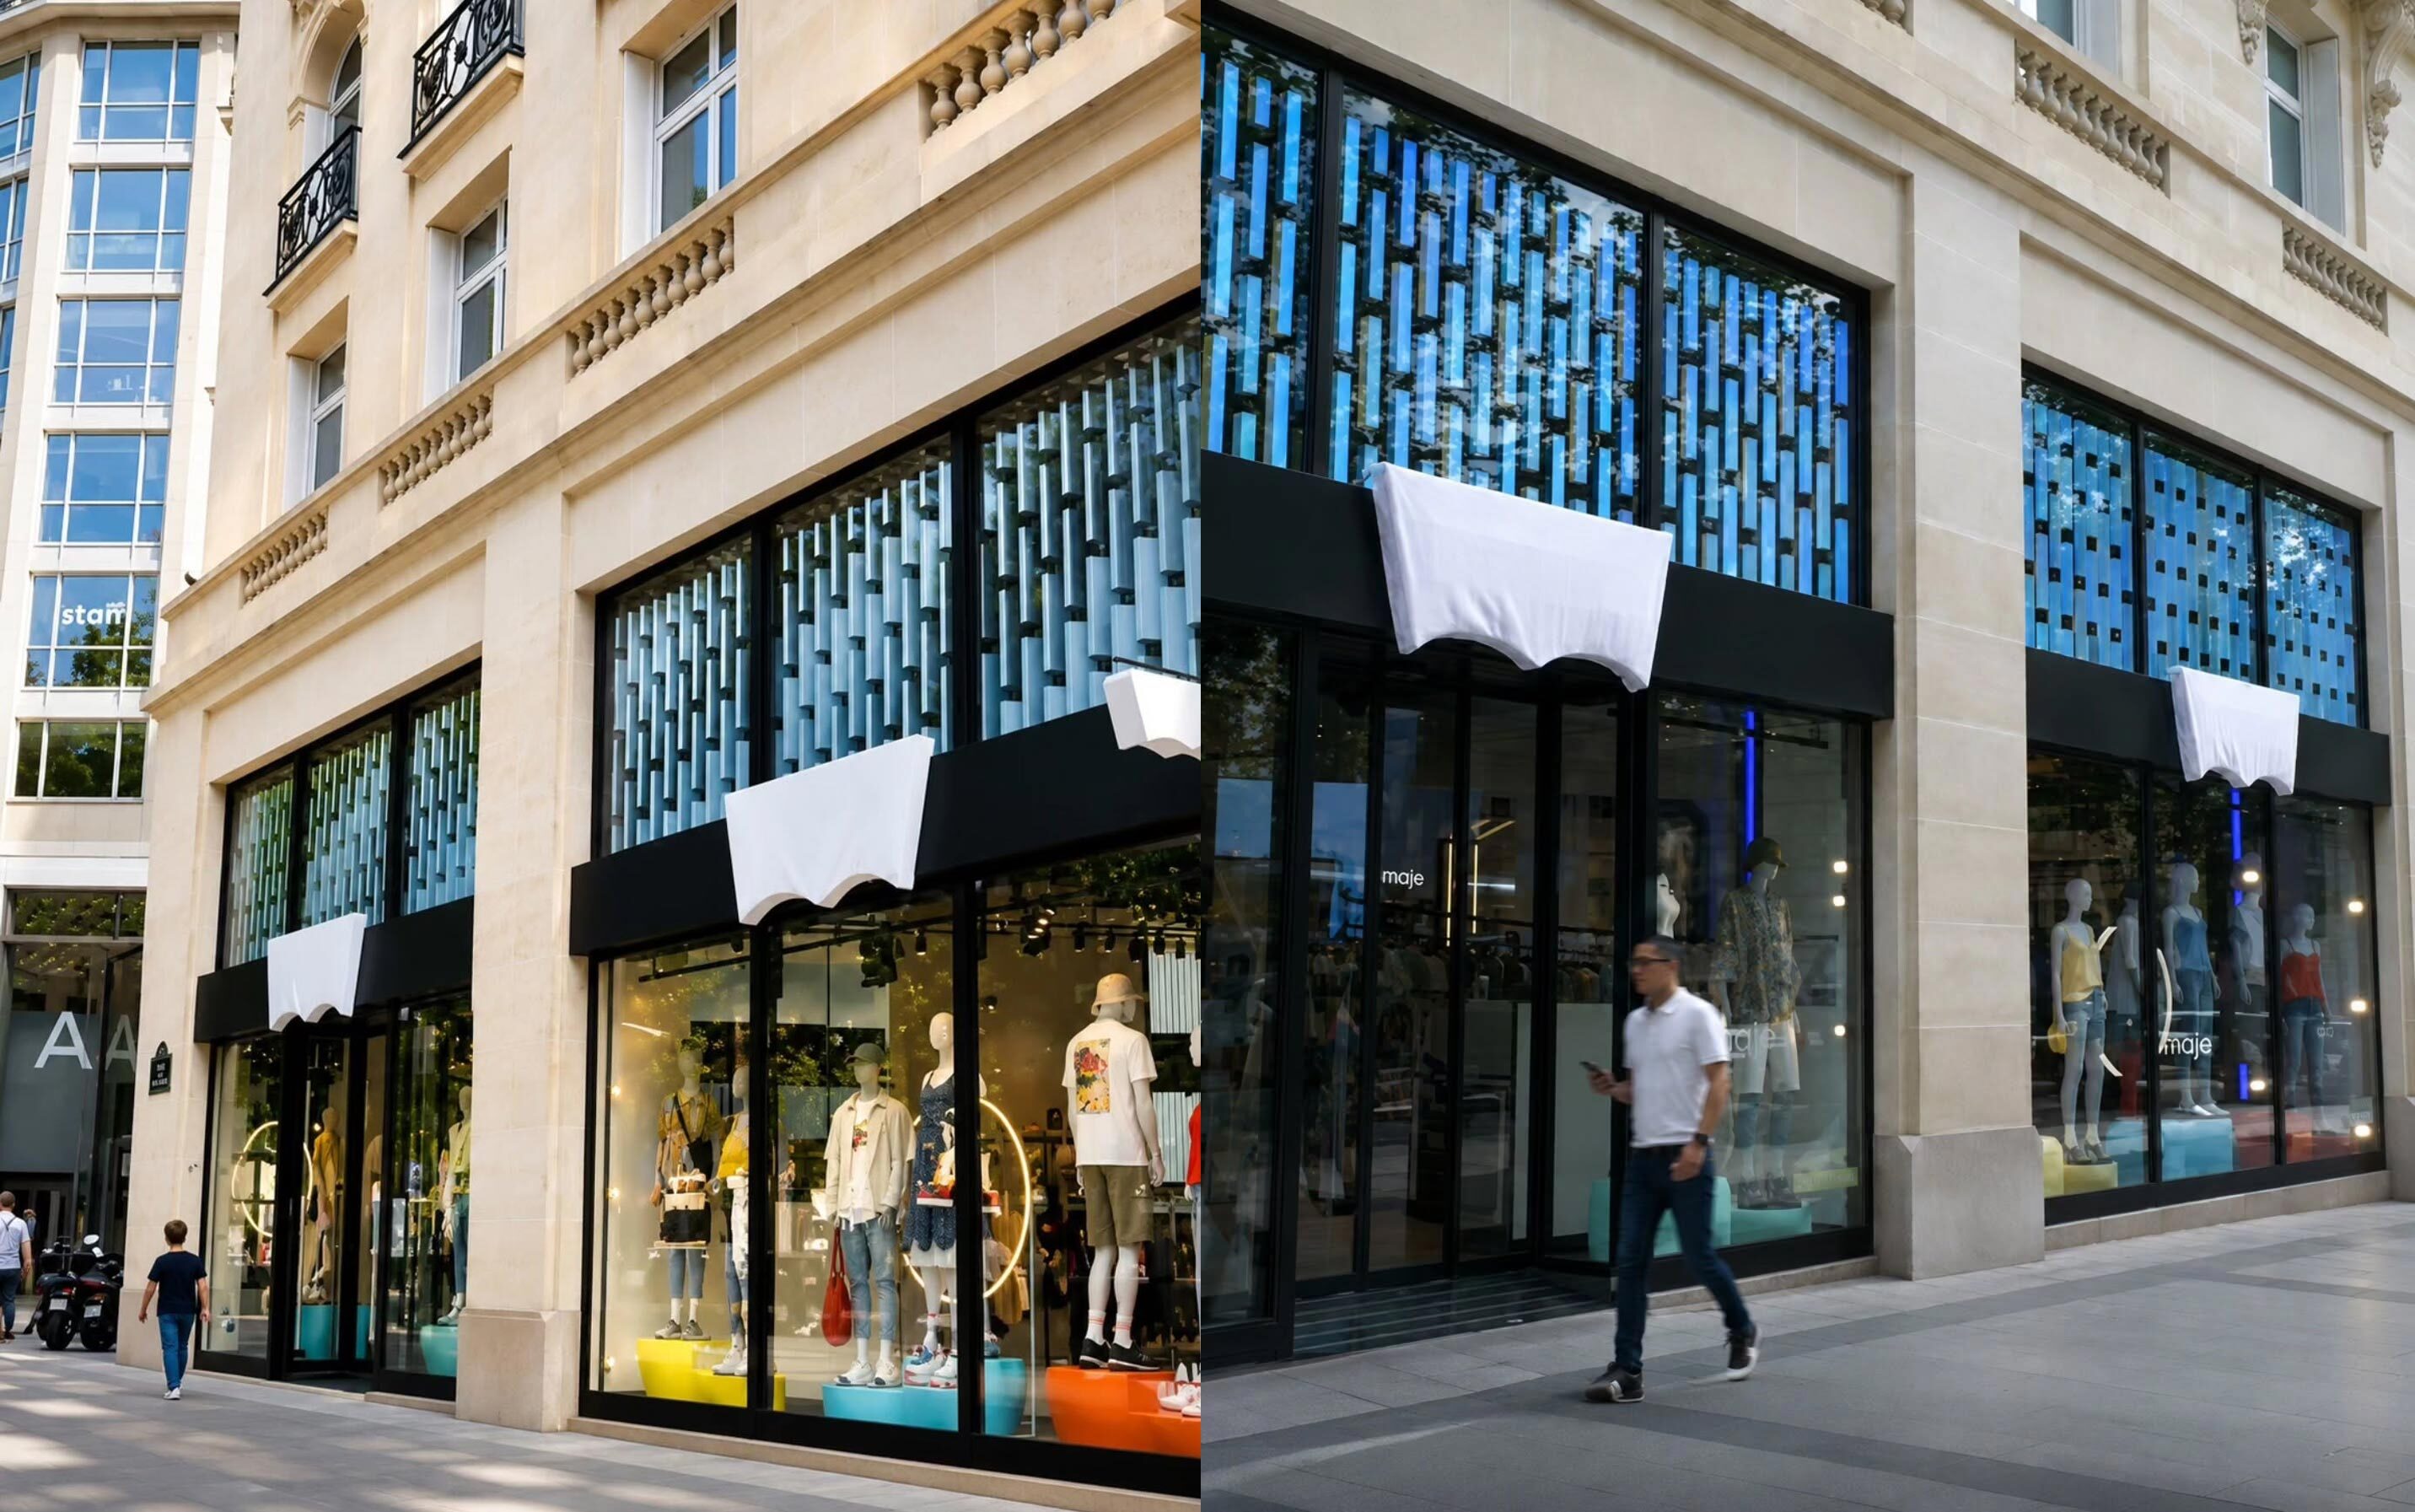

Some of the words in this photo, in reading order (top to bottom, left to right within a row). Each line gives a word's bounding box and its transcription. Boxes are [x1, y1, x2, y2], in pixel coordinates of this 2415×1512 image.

[1382, 869, 1424, 890] maje
[34, 1010, 93, 1070] A
[2164, 1032, 2213, 1060] maje
